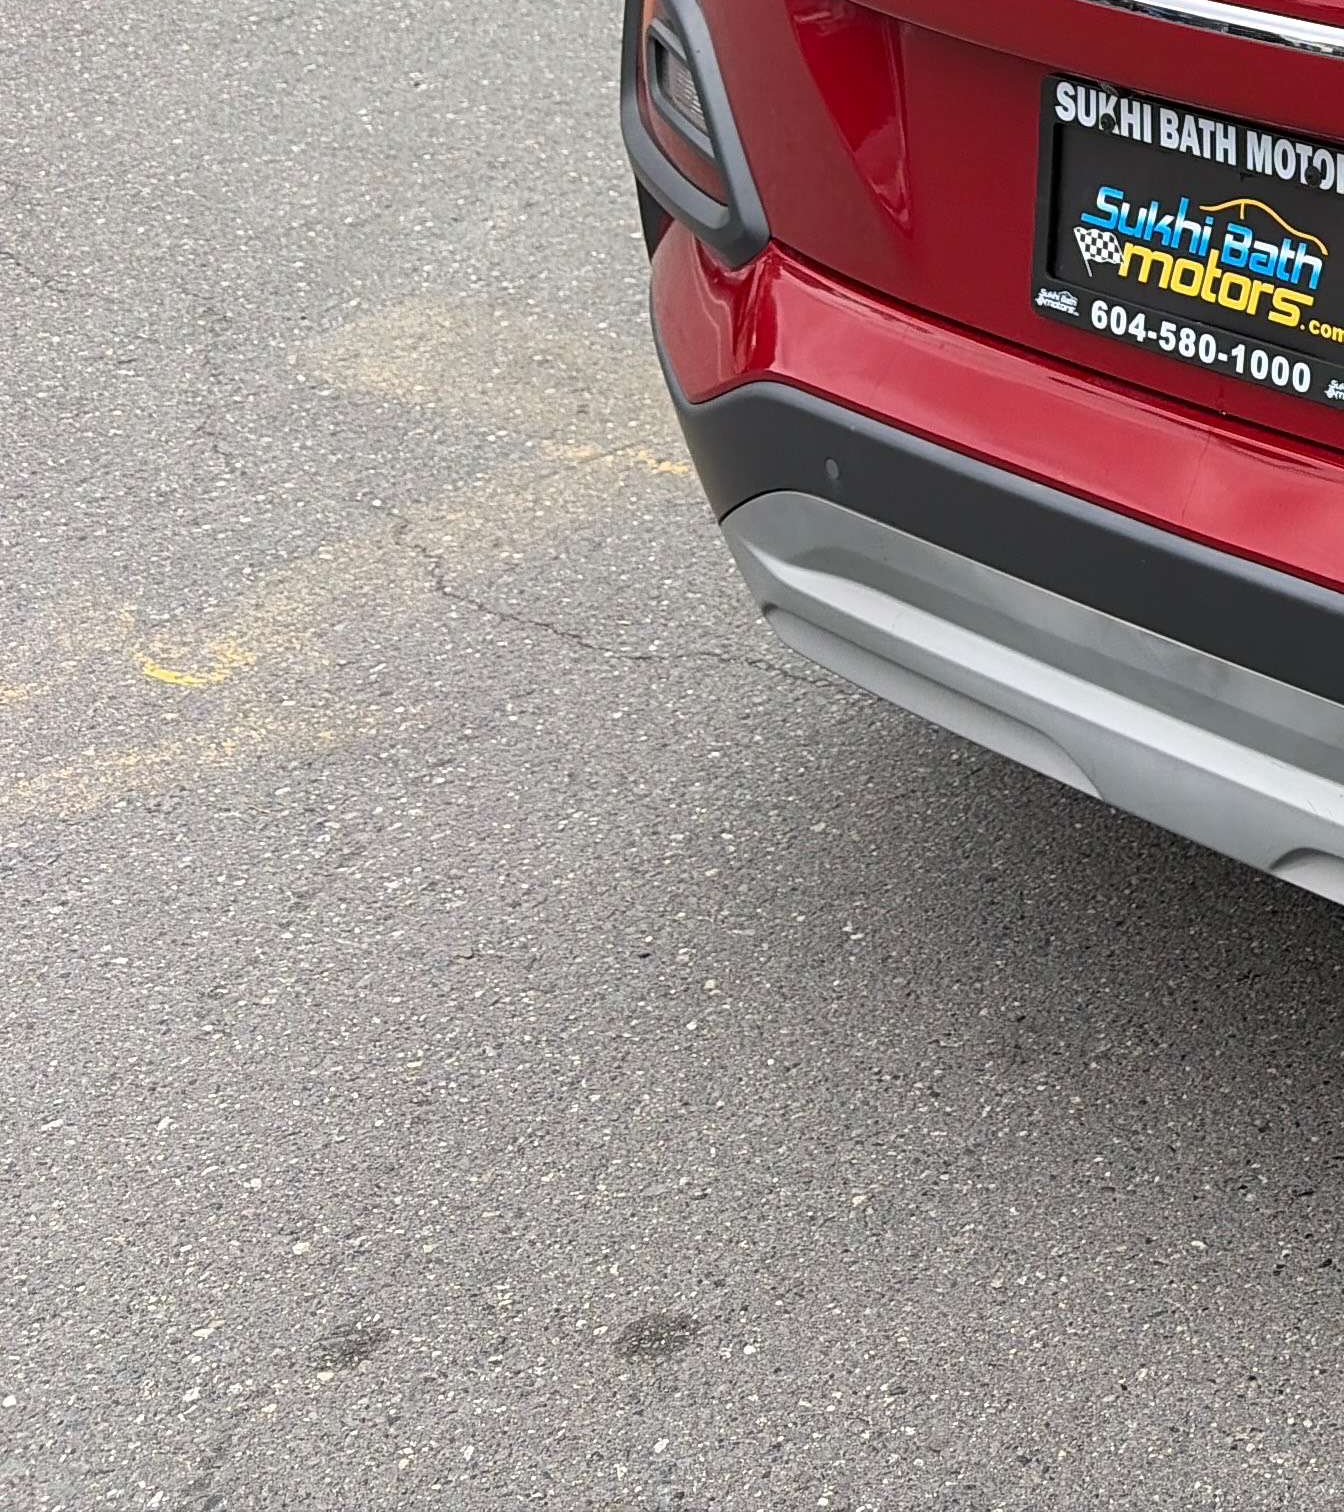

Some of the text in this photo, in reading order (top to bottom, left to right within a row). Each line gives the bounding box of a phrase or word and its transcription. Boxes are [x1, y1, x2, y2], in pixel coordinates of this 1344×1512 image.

[1055, 81, 1152, 144] SUKHI
[1160, 108, 1236, 166] BATH
[1080, 186, 1323, 289] Sukhi Bath
[1090, 300, 1311, 392] 604-580-1000
